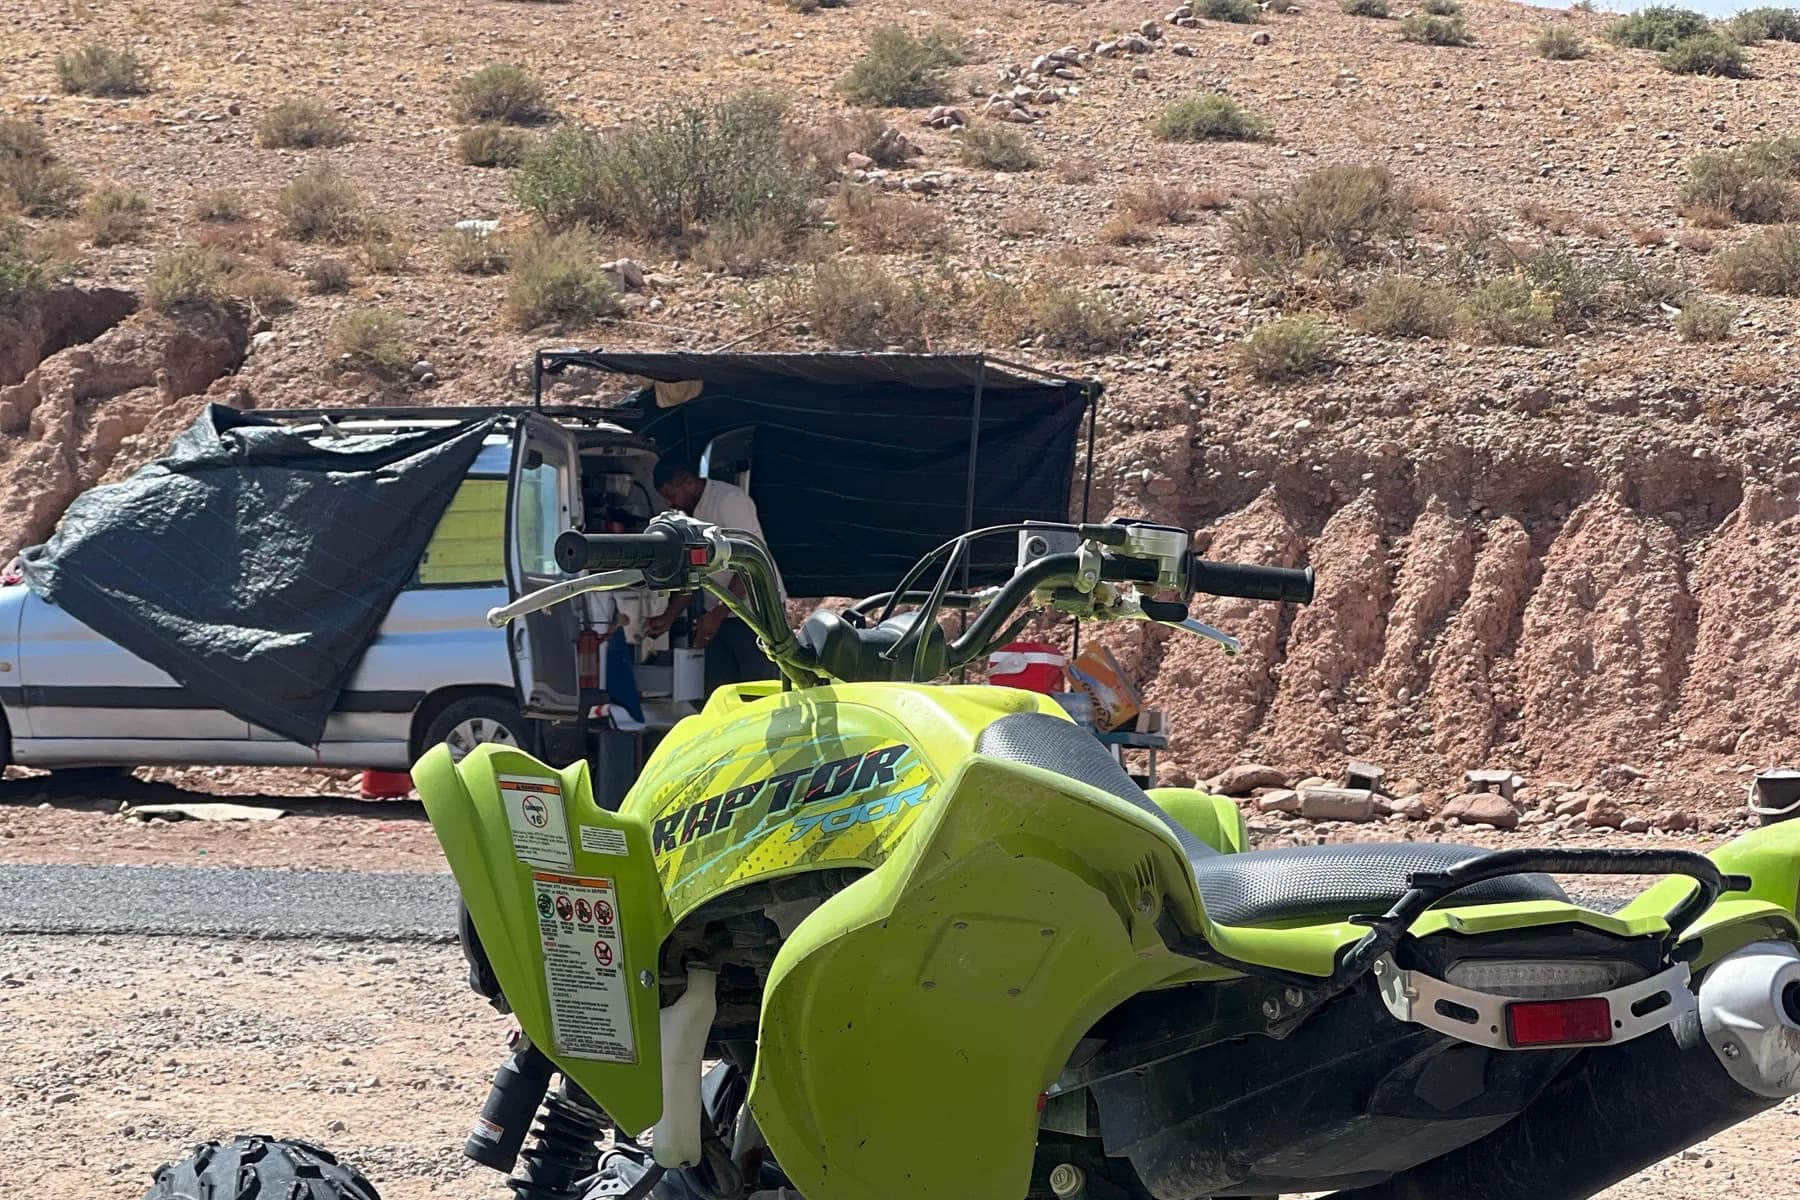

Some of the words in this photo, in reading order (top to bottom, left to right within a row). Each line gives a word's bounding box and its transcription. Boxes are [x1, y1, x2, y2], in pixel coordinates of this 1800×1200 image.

[531, 814, 544, 825] 16
[652, 744, 911, 857] RAPTOR
[785, 784, 931, 843] 700R
